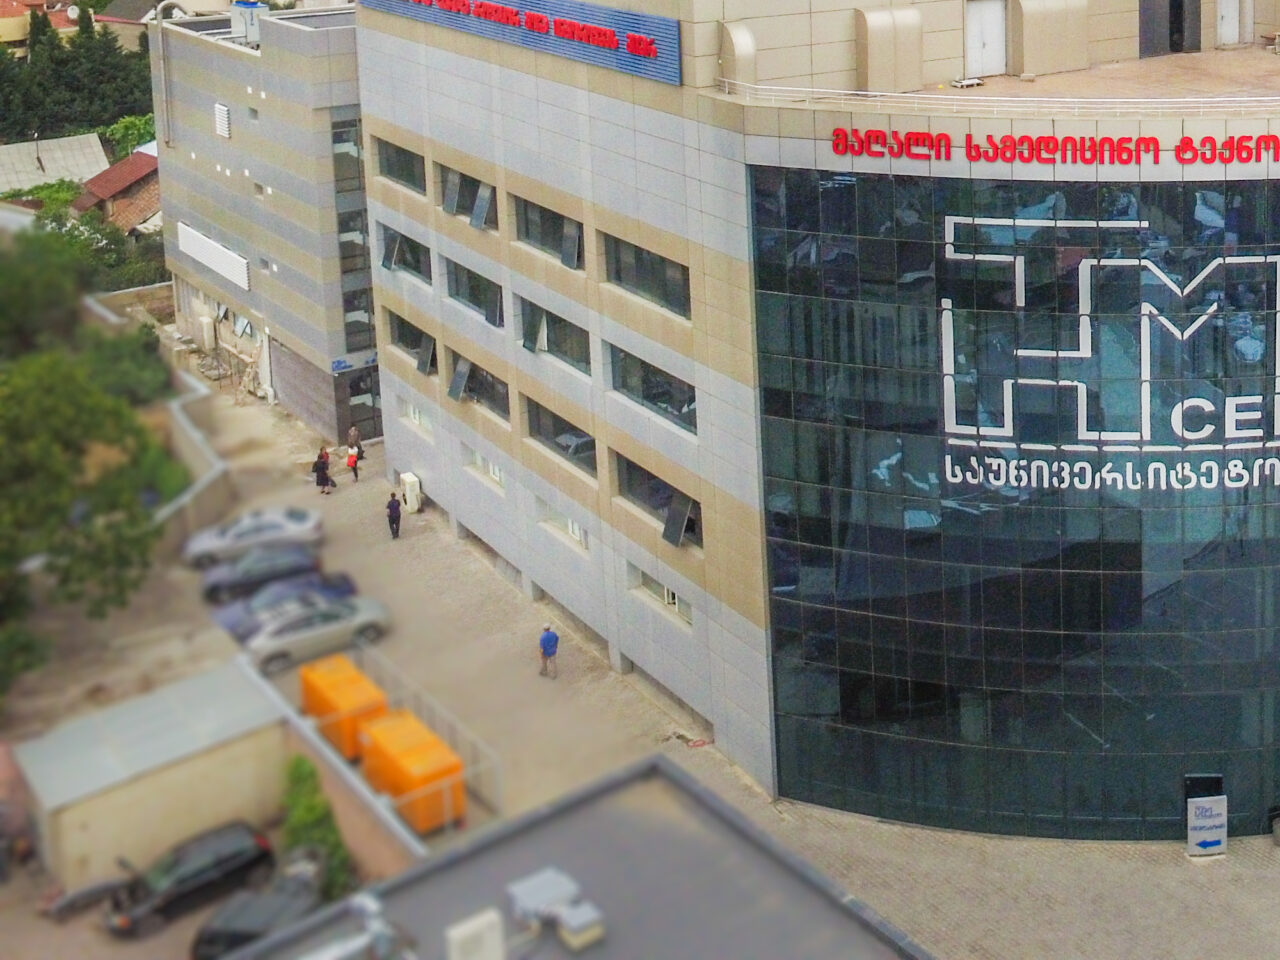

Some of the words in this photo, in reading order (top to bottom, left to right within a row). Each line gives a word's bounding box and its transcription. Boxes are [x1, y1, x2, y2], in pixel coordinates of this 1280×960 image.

[832, 128, 953, 161] მაღალი
[965, 133, 1161, 166] სამედიცინო
[944, 454, 1280, 490] საუნივერსიტეტო
